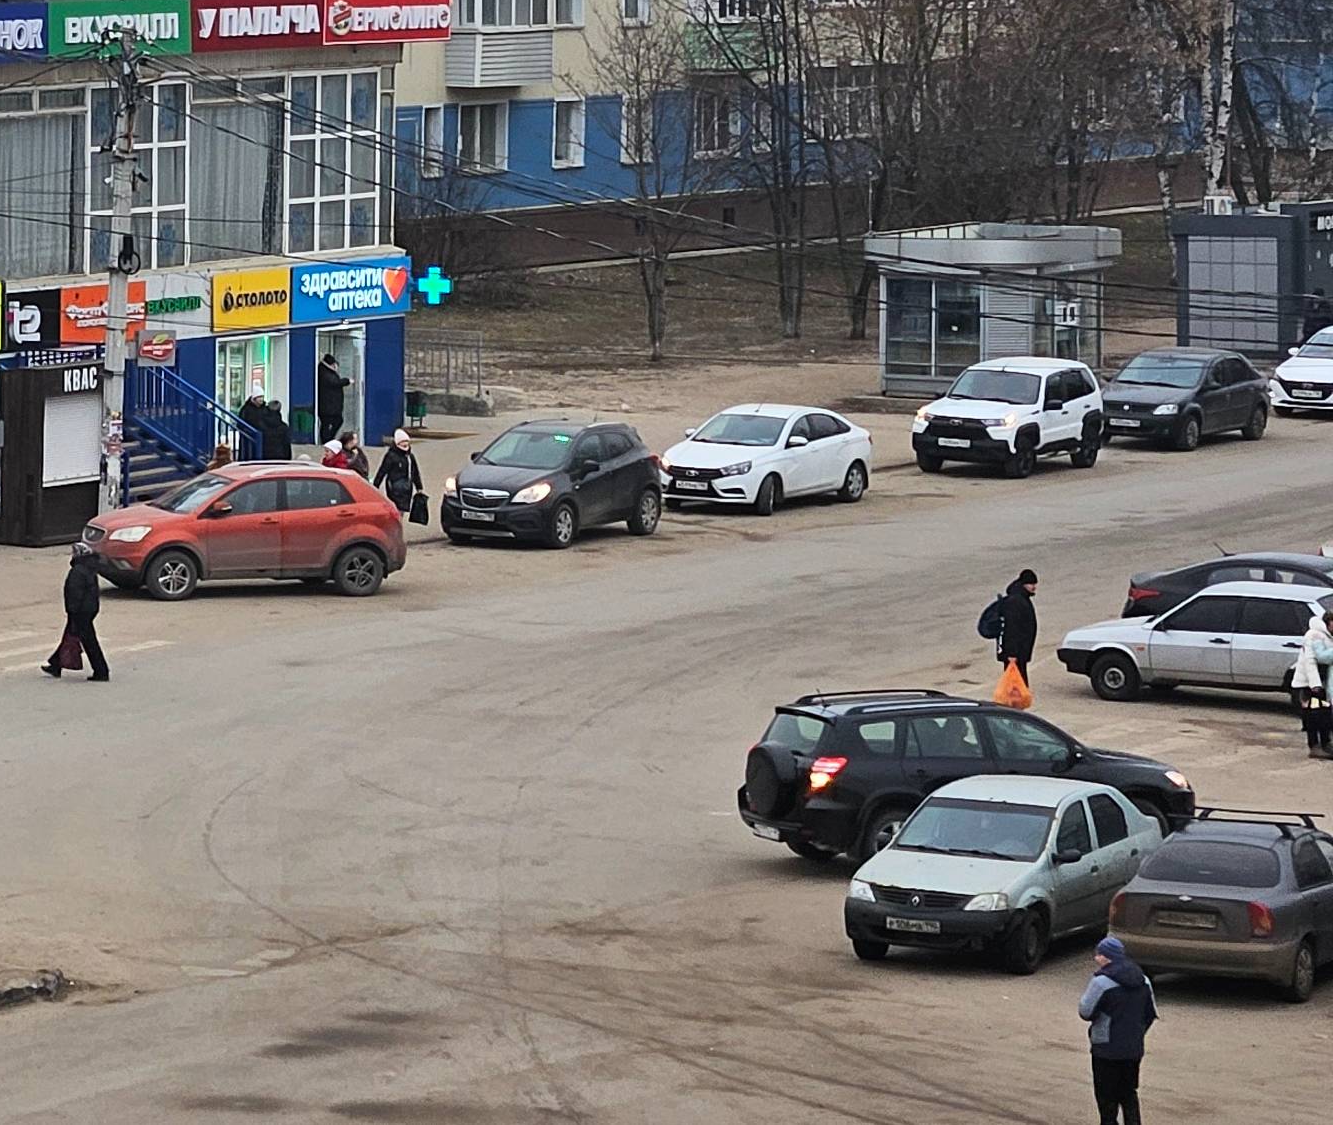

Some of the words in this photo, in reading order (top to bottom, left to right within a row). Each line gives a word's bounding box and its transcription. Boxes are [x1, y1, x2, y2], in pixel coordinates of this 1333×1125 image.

[64, 12, 180, 44] ВКУСВИЛЛ
[197, 8, 218, 39] У
[218, 4, 321, 38] ПАЛЫЧА
[350, 3, 452, 32] ЕРМОЛИНО
[300, 267, 383, 299] здравсити
[147, 296, 202, 316] ВКУСВИЛЛ
[328, 288, 383, 312] аптека
[63, 366, 98, 393] КВАС
